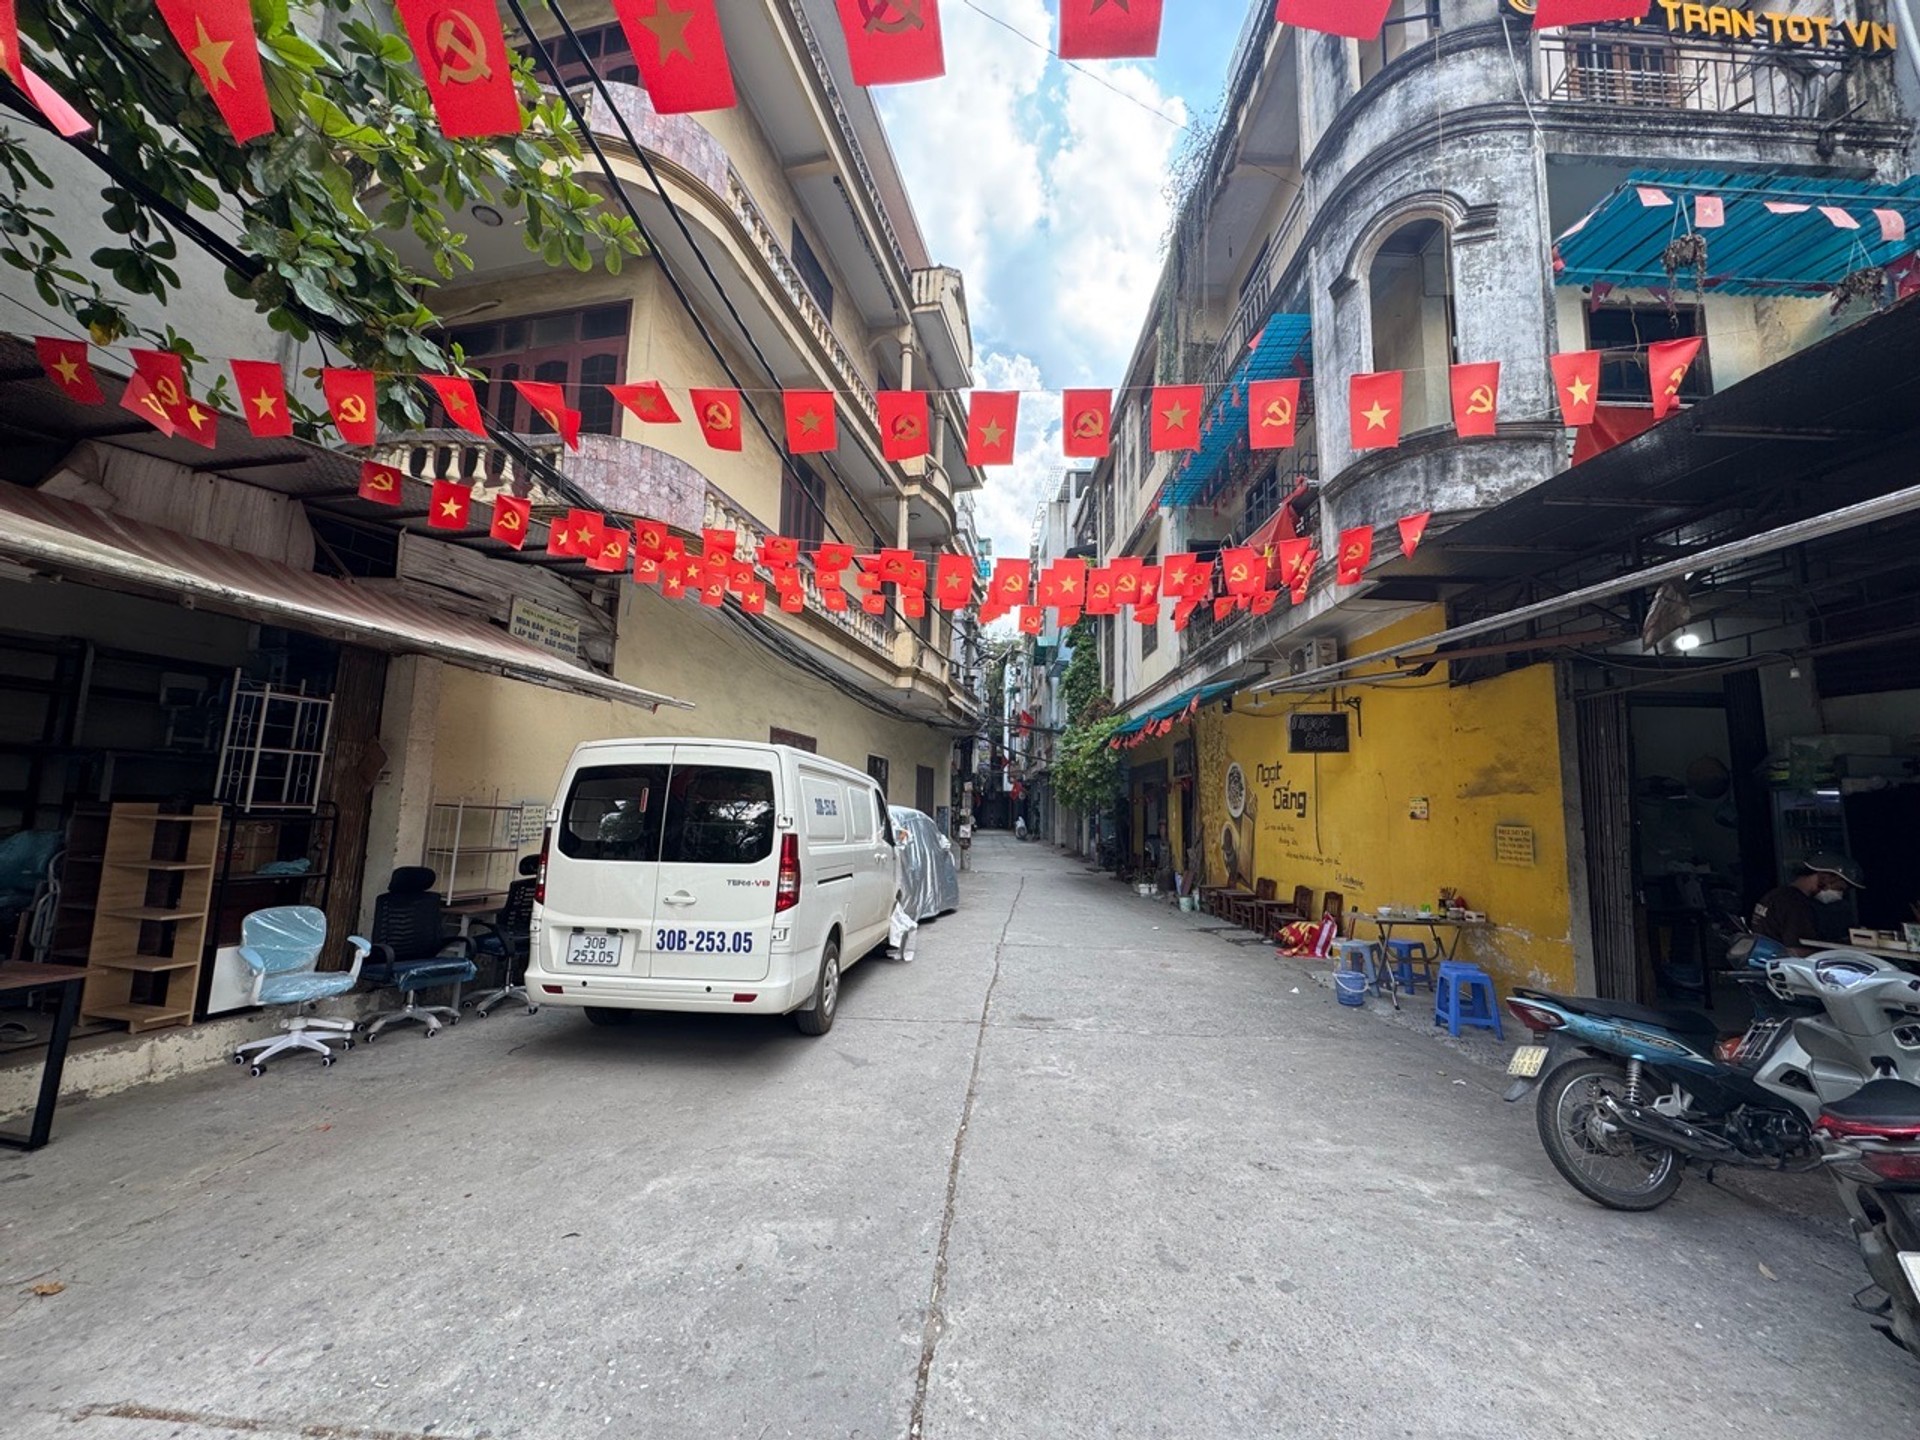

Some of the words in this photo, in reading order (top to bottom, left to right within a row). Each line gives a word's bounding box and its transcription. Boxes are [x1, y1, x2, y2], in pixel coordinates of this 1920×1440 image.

[1657, 0, 1756, 39] TRAN
[1762, 12, 1833, 48] TOT
[1844, 20, 1897, 53] VN
[584, 936, 607, 949] 30B
[656, 929, 753, 954] 30B-253.05
[573, 950, 614, 963] 253.05
